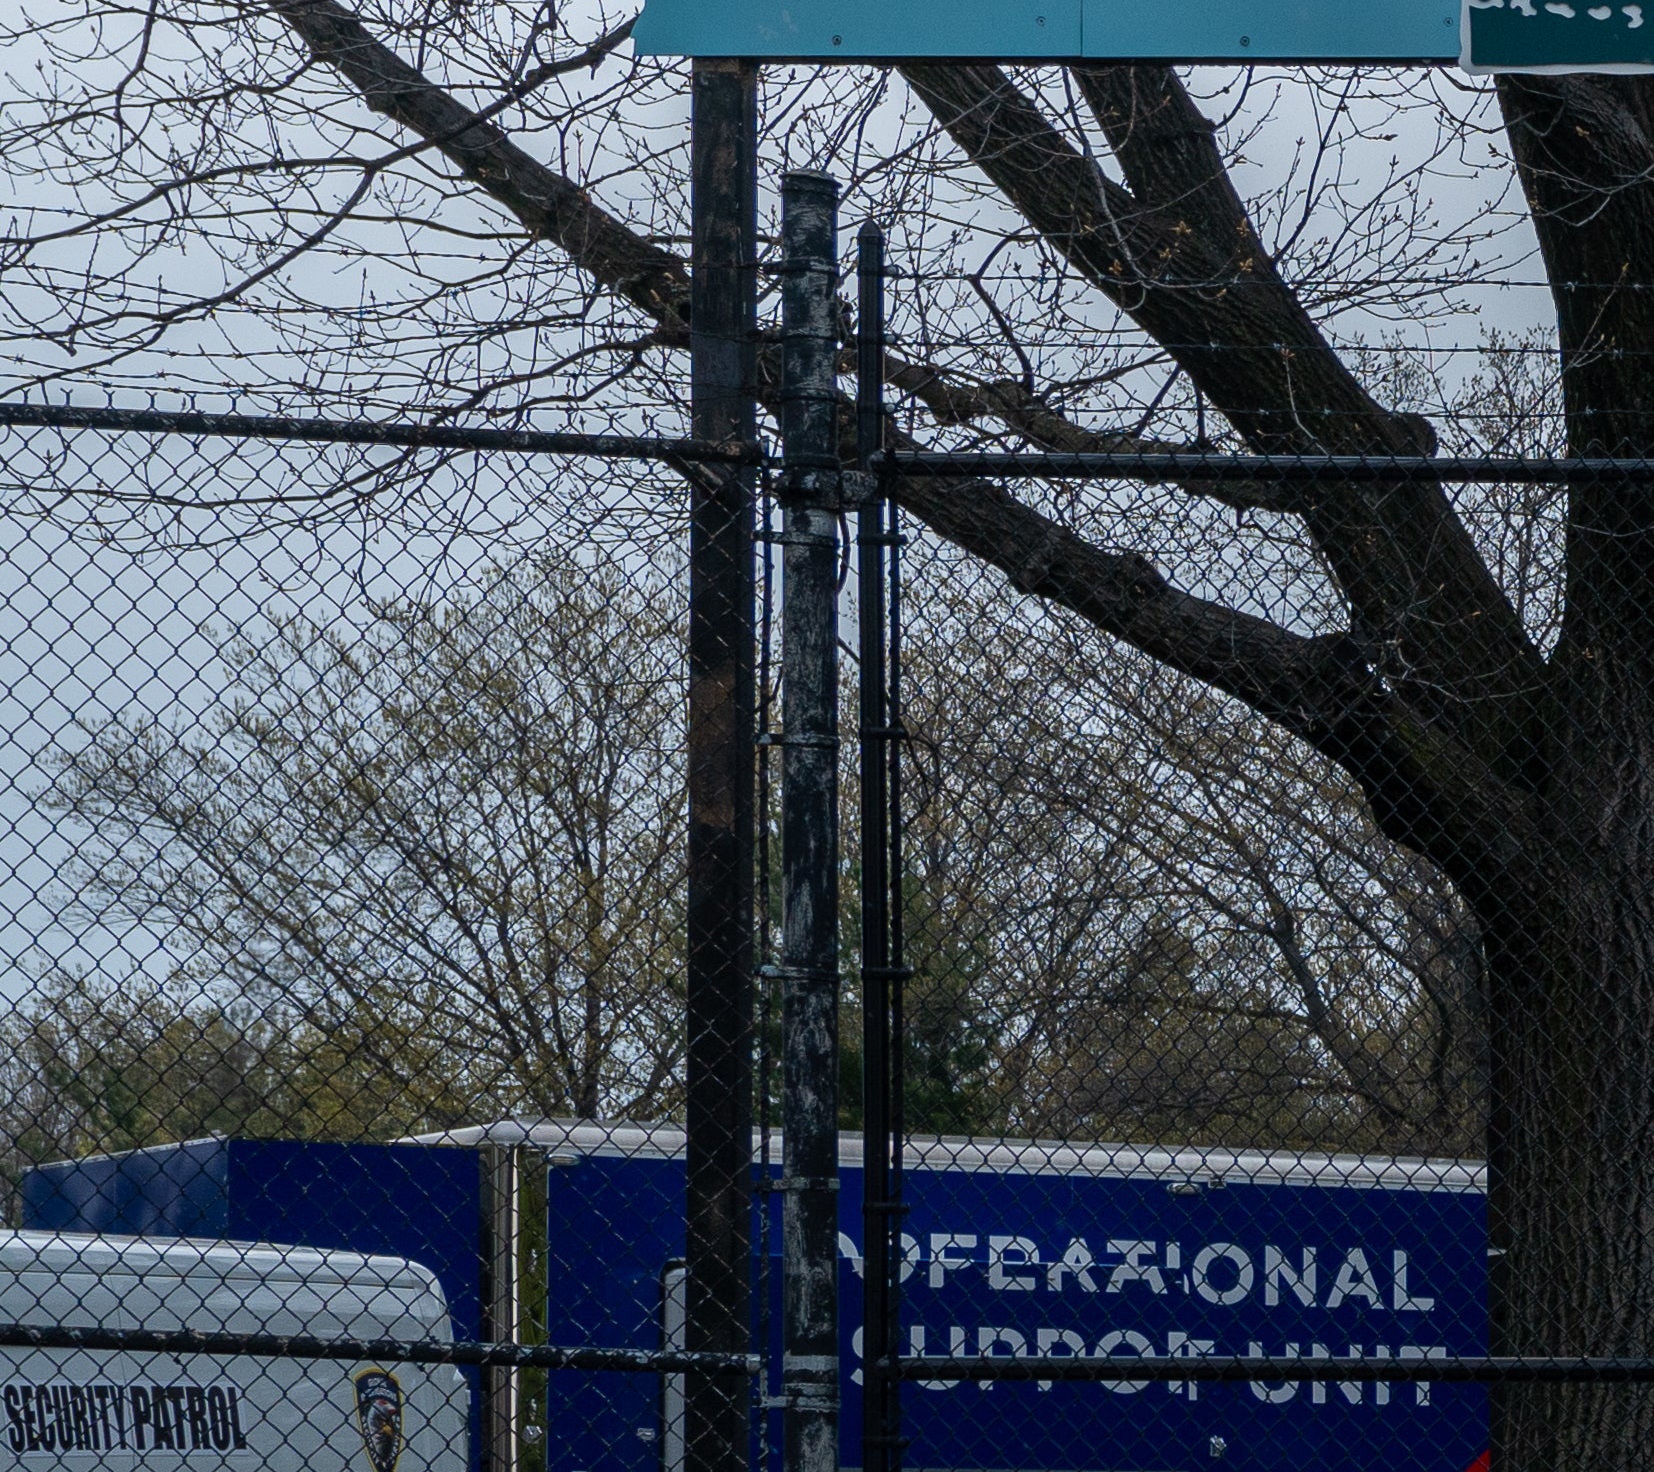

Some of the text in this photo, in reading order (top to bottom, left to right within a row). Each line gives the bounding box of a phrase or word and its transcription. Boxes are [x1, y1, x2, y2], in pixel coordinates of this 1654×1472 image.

[1248, 1340, 1446, 1407] UNIT
[4, 1384, 247, 1453] SECURITY PATROL
